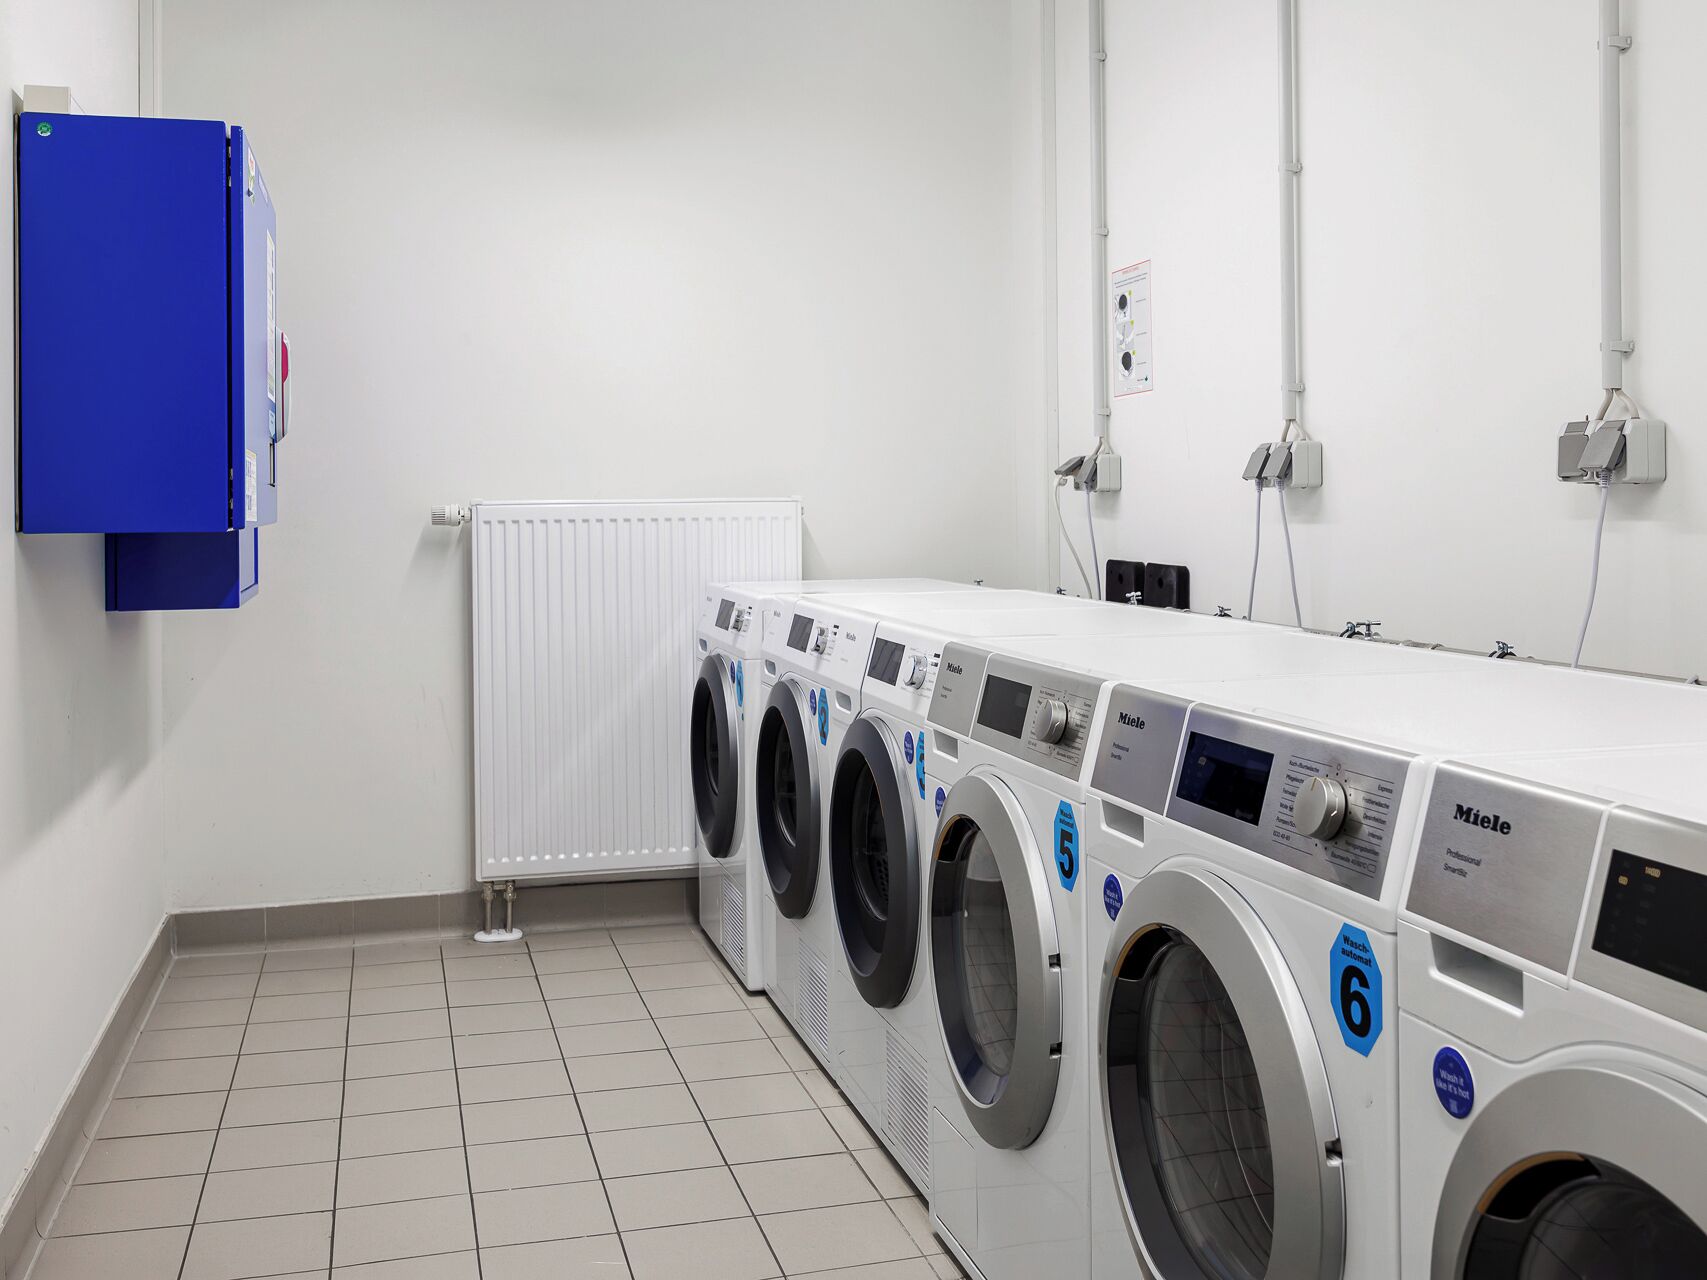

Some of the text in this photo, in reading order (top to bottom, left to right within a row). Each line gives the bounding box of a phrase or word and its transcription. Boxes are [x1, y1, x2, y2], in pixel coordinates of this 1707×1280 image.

[820, 706, 827, 738] 2
[1118, 711, 1146, 730] Miele
[1377, 784, 1393, 794] Express
[1453, 803, 1511, 836] Miele
[1060, 828, 1074, 880] 5
[1446, 847, 1482, 867] Professional
[1342, 934, 1370, 954] Wasch-
[1341, 947, 1372, 968] automat
[1340, 964, 1372, 1039] 6
[1439, 1068, 1459, 1084] Wash
